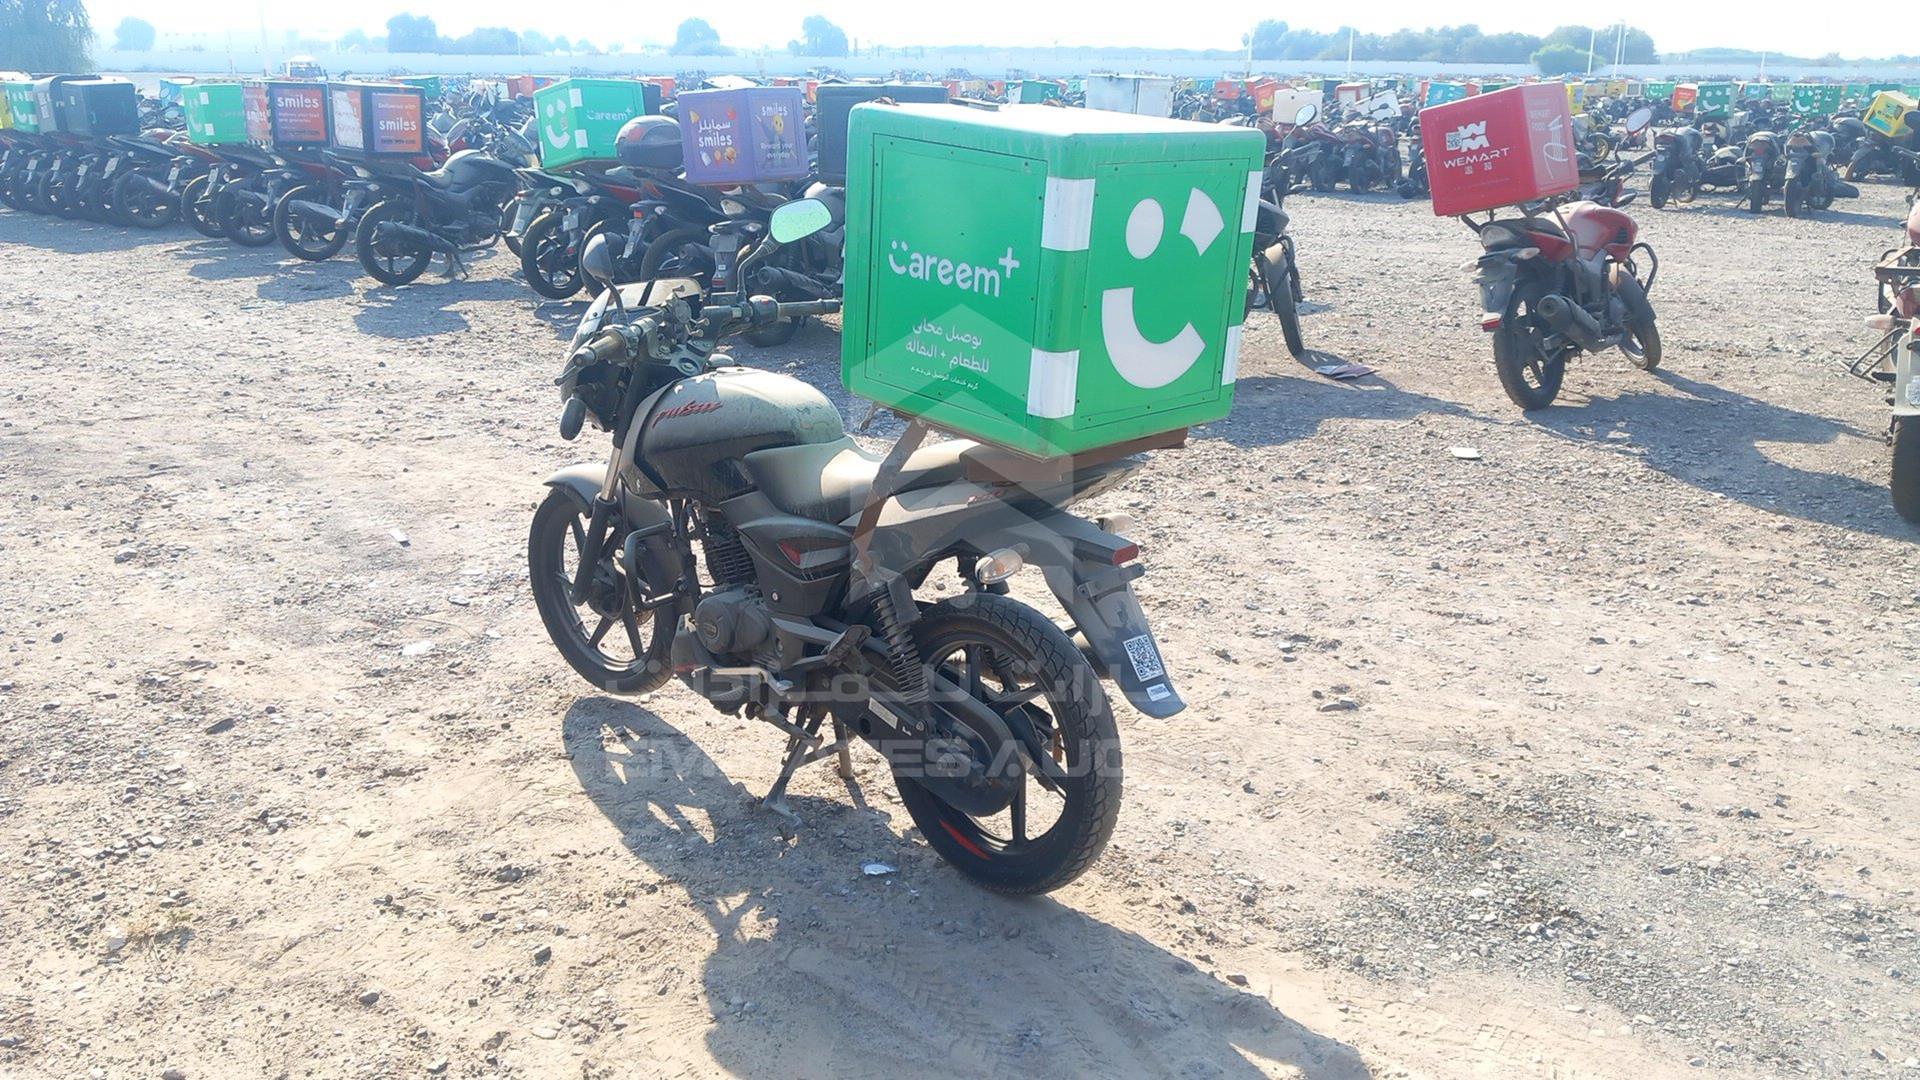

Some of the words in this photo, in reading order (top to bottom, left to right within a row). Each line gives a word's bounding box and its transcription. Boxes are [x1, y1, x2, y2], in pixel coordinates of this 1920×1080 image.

[277, 95, 320, 108] smiles
[761, 103, 788, 115] smiles
[379, 117, 417, 131] smiles
[698, 132, 733, 147] smiles
[1443, 147, 1510, 168] WEMART
